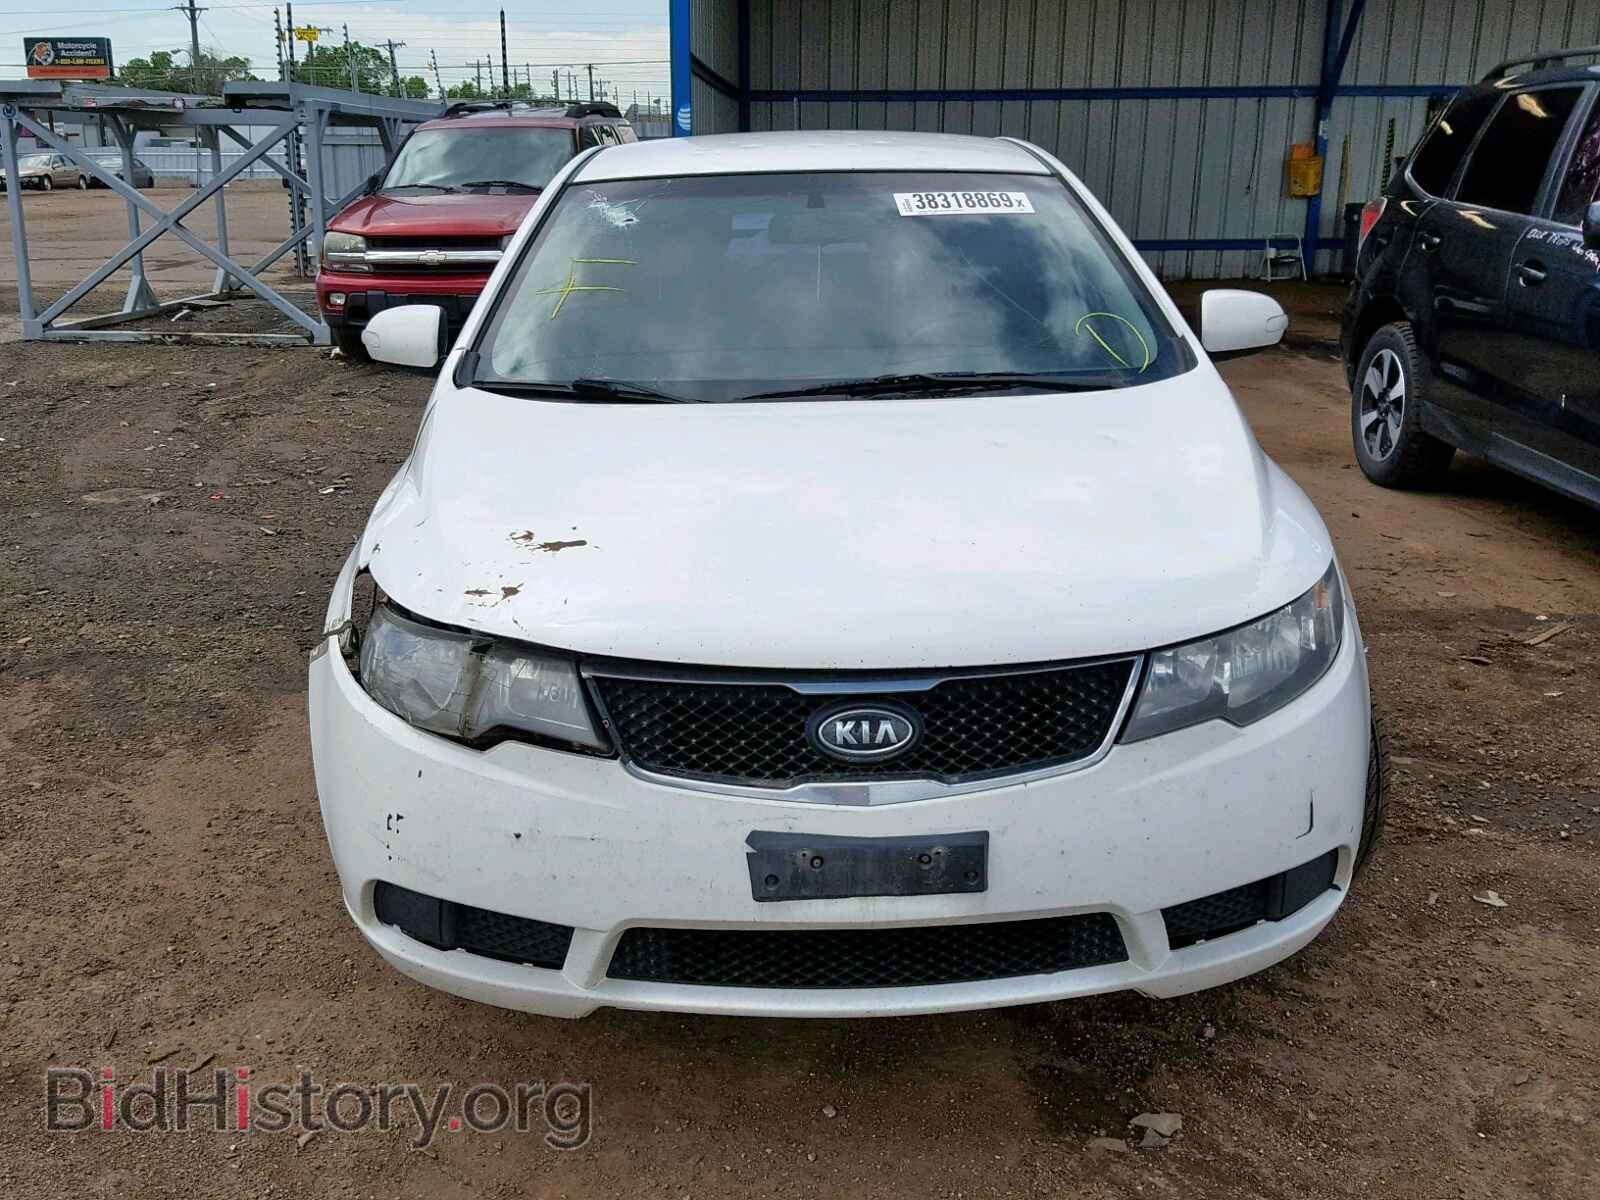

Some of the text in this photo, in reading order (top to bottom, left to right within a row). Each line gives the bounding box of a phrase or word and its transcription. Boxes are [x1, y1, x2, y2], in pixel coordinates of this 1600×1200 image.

[57, 42, 97, 50] Motorcycle
[912, 192, 1014, 209] 38318869
[835, 720, 898, 745] KIA
